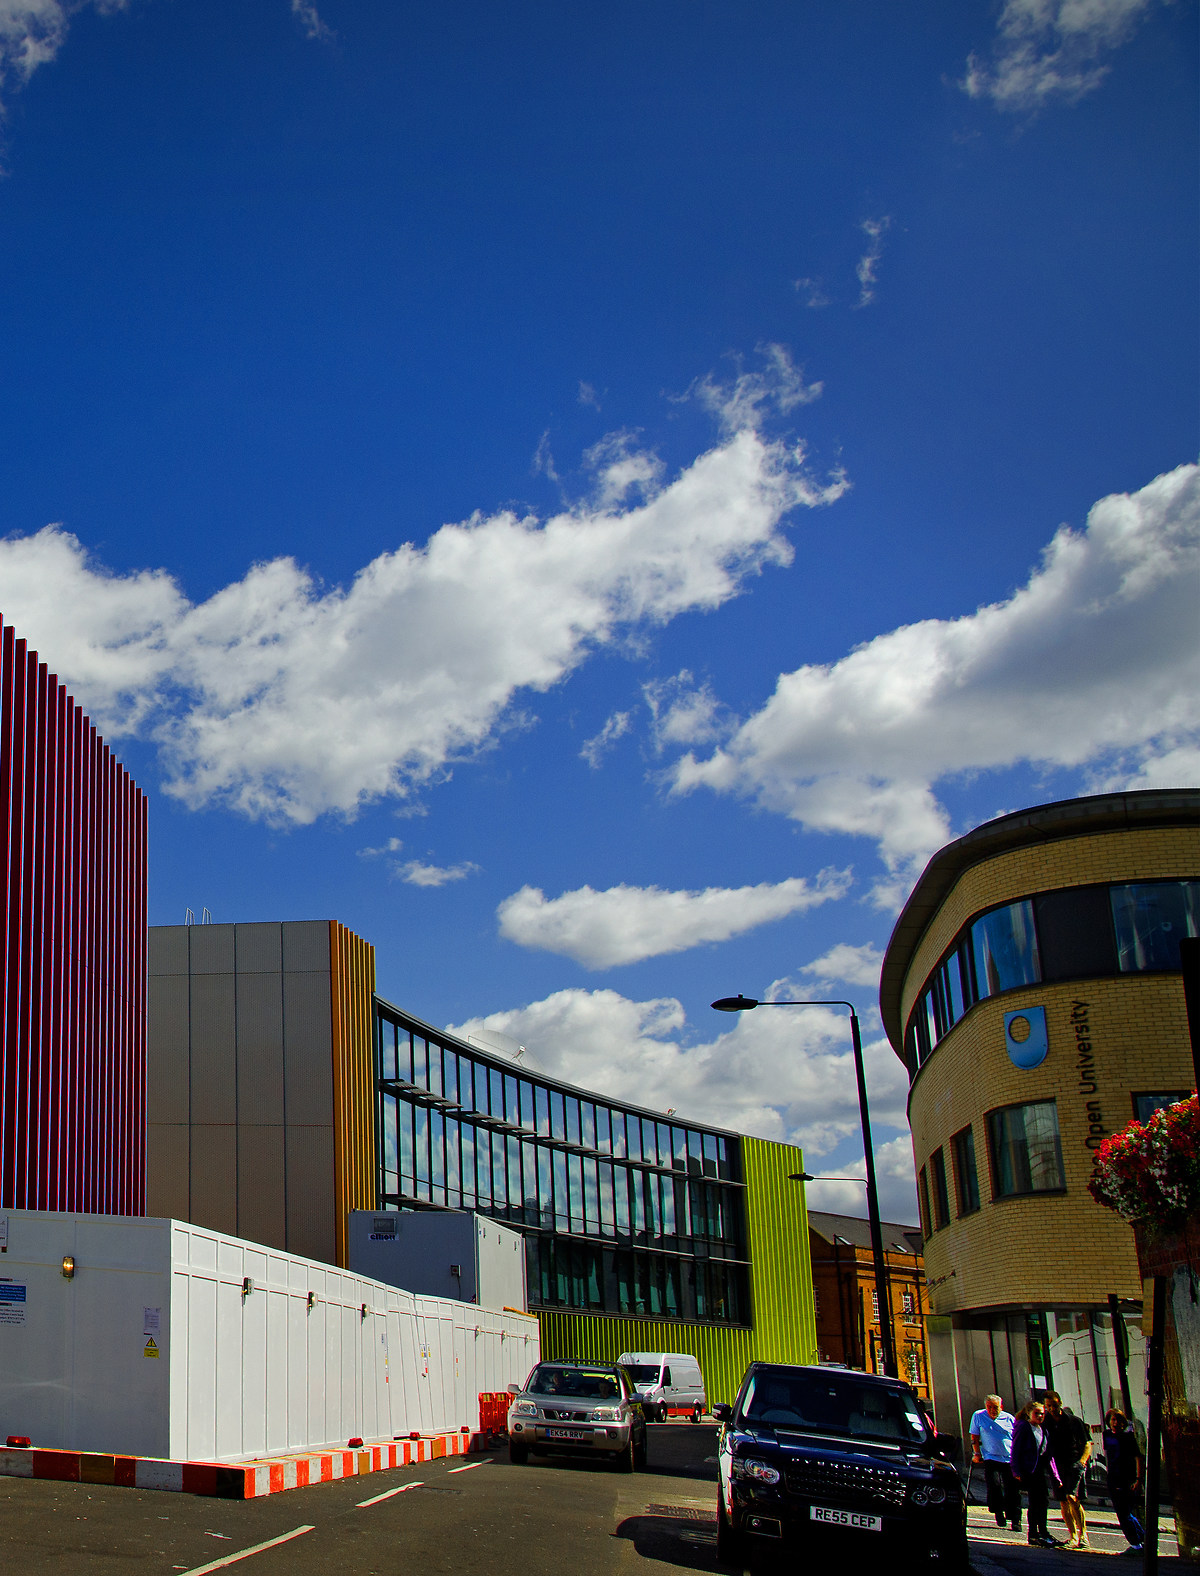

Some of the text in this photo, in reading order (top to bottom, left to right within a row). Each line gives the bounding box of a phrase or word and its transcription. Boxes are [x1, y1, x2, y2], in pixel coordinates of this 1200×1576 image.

[1069, 1000, 1097, 1095] University
[550, 1430, 583, 1439] EK54 RRV
[815, 1507, 876, 1528] RE55 CEP
